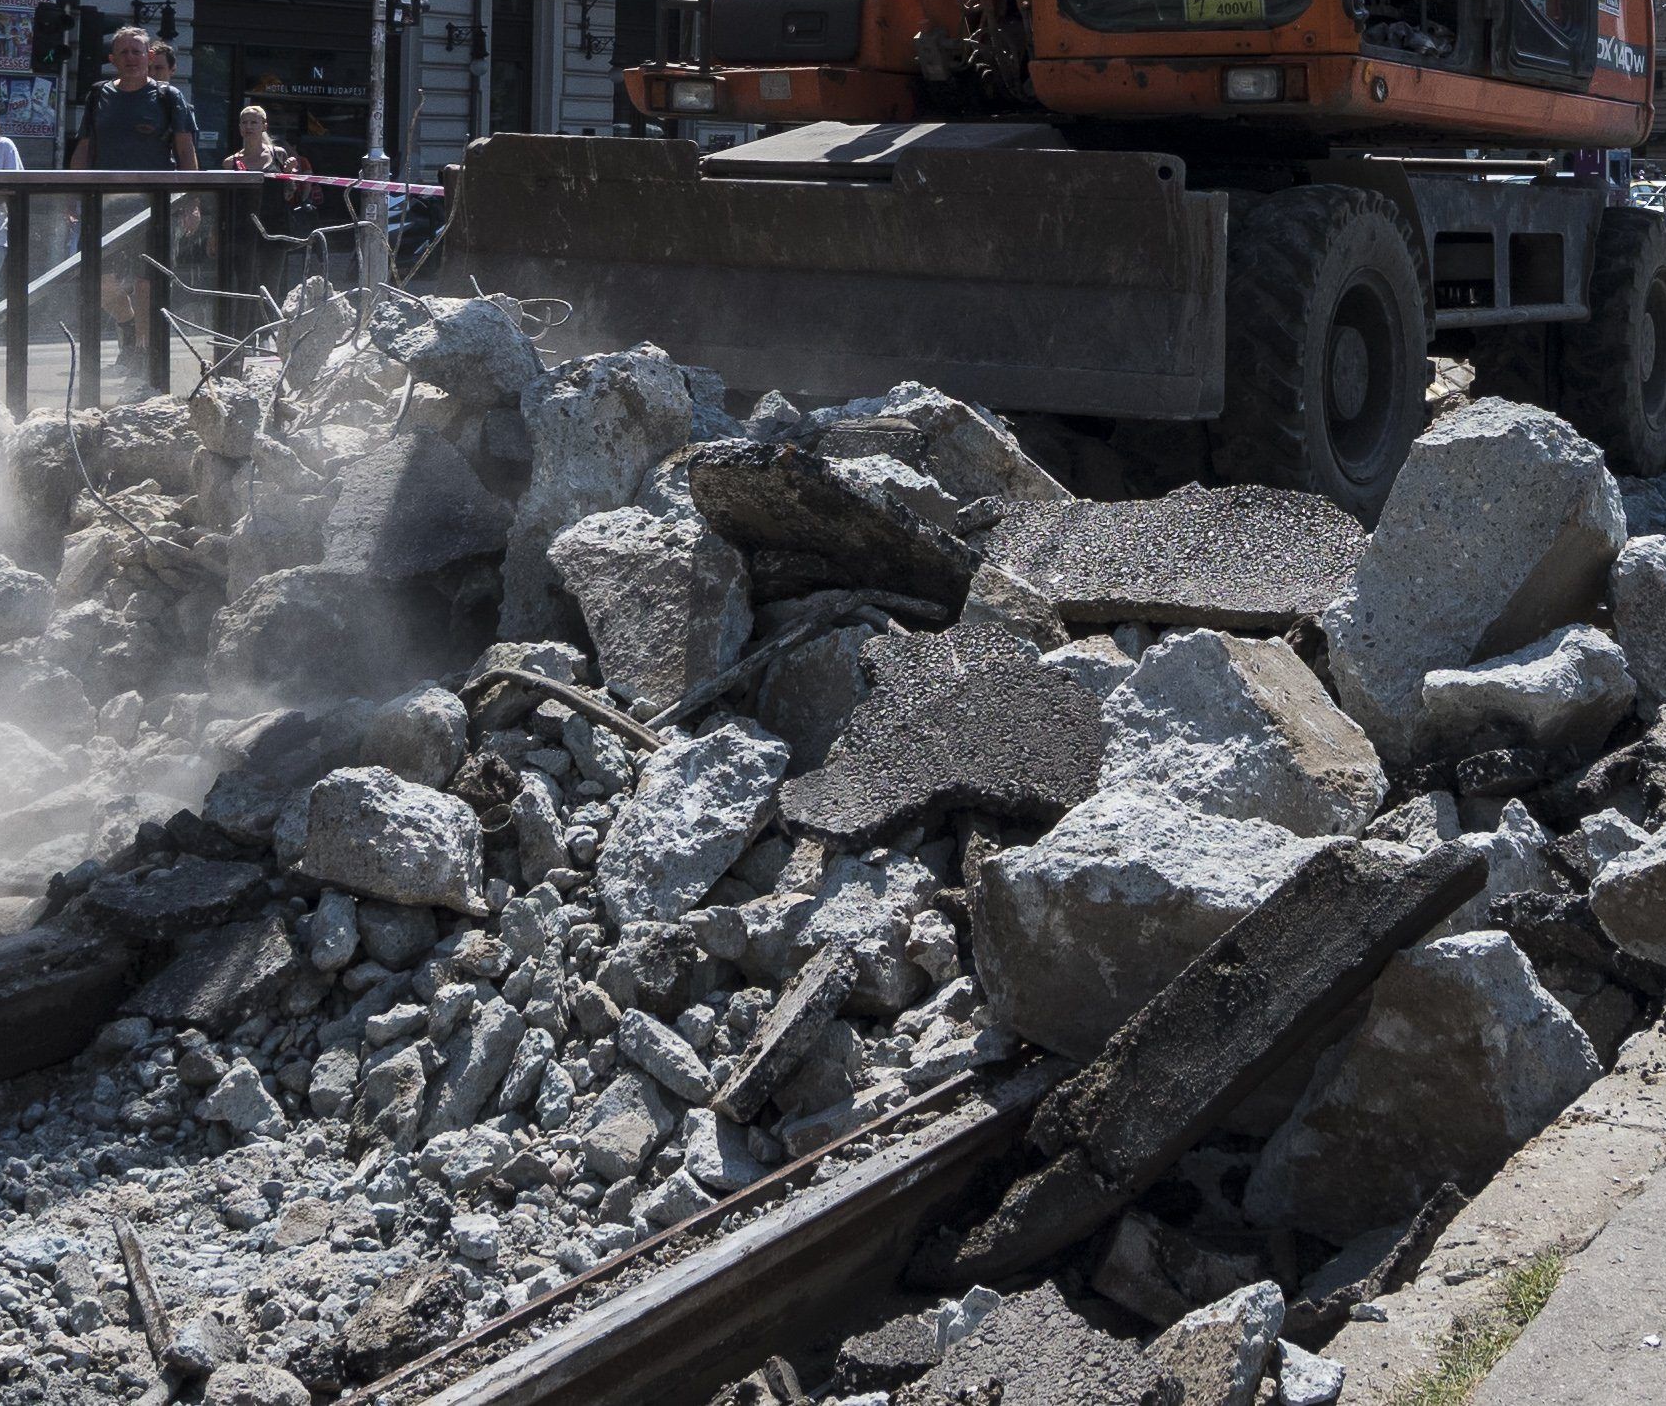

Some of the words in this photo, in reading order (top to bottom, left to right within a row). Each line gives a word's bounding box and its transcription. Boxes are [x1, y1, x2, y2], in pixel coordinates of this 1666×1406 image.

[1216, 0, 1253, 16] 400V!
[265, 84, 289, 93] HOTEL
[291, 84, 325, 94] NEMZETI
[327, 85, 366, 96] BUDAPEST
